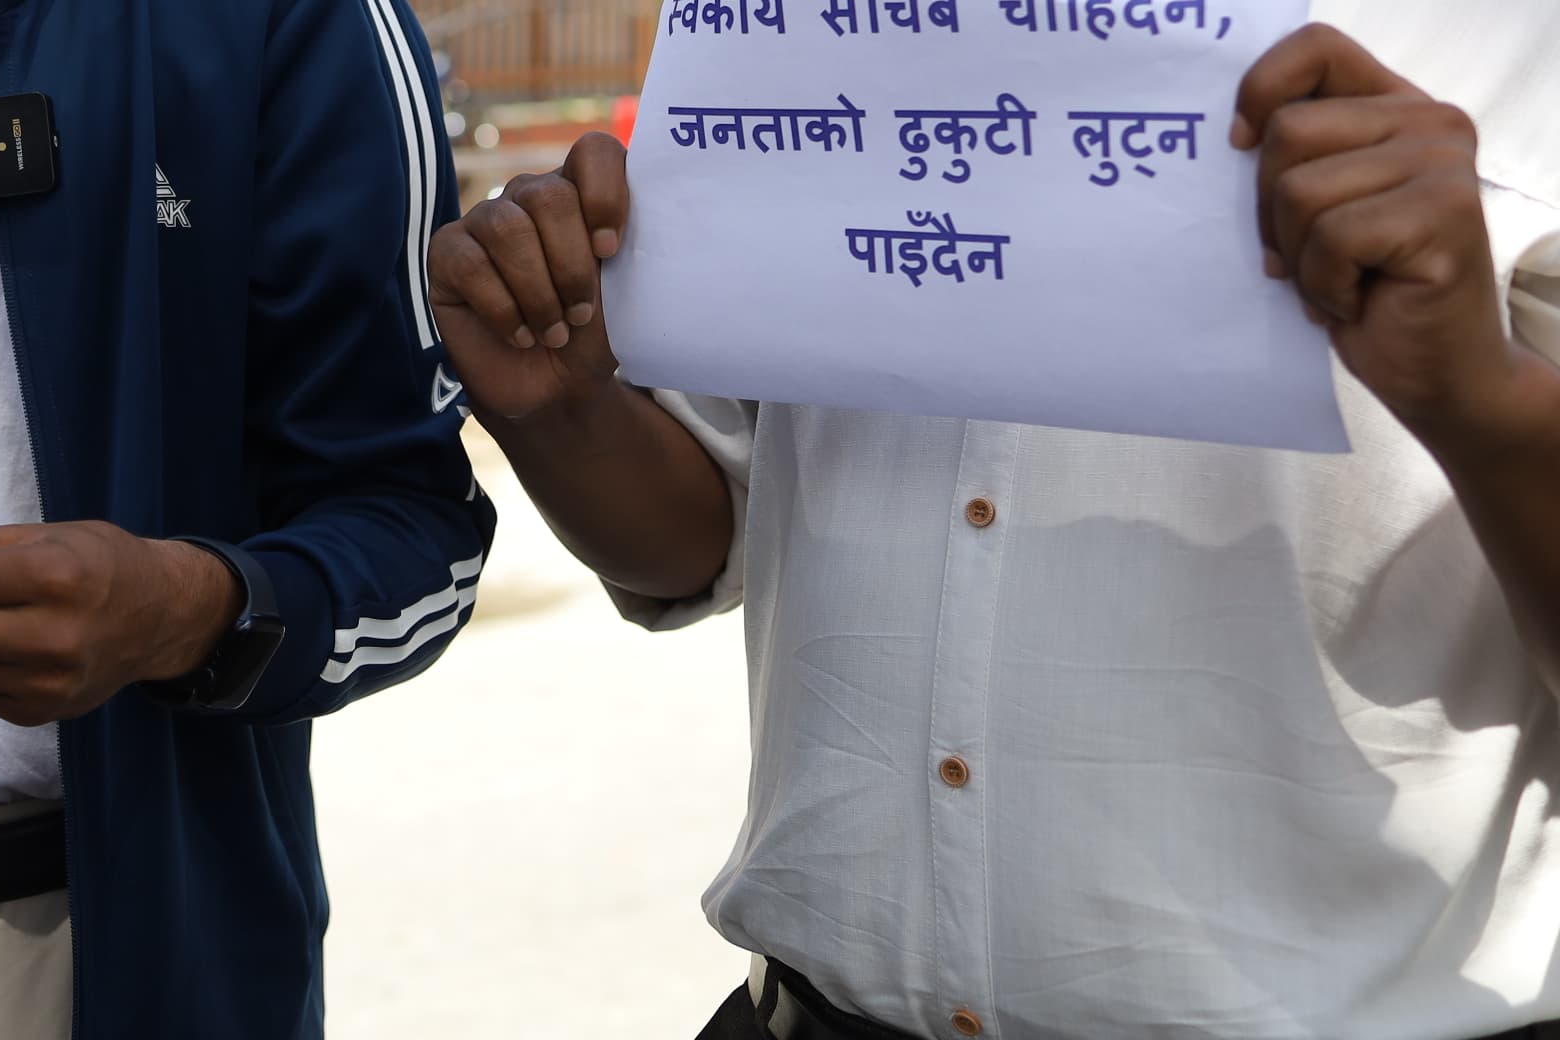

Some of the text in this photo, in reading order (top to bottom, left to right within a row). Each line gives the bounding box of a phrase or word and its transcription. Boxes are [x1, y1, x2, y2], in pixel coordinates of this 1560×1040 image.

[668, 94, 866, 153] जनताको
[894, 92, 1037, 183] ढुकुटी
[845, 210, 1011, 288] पाइँदैन
